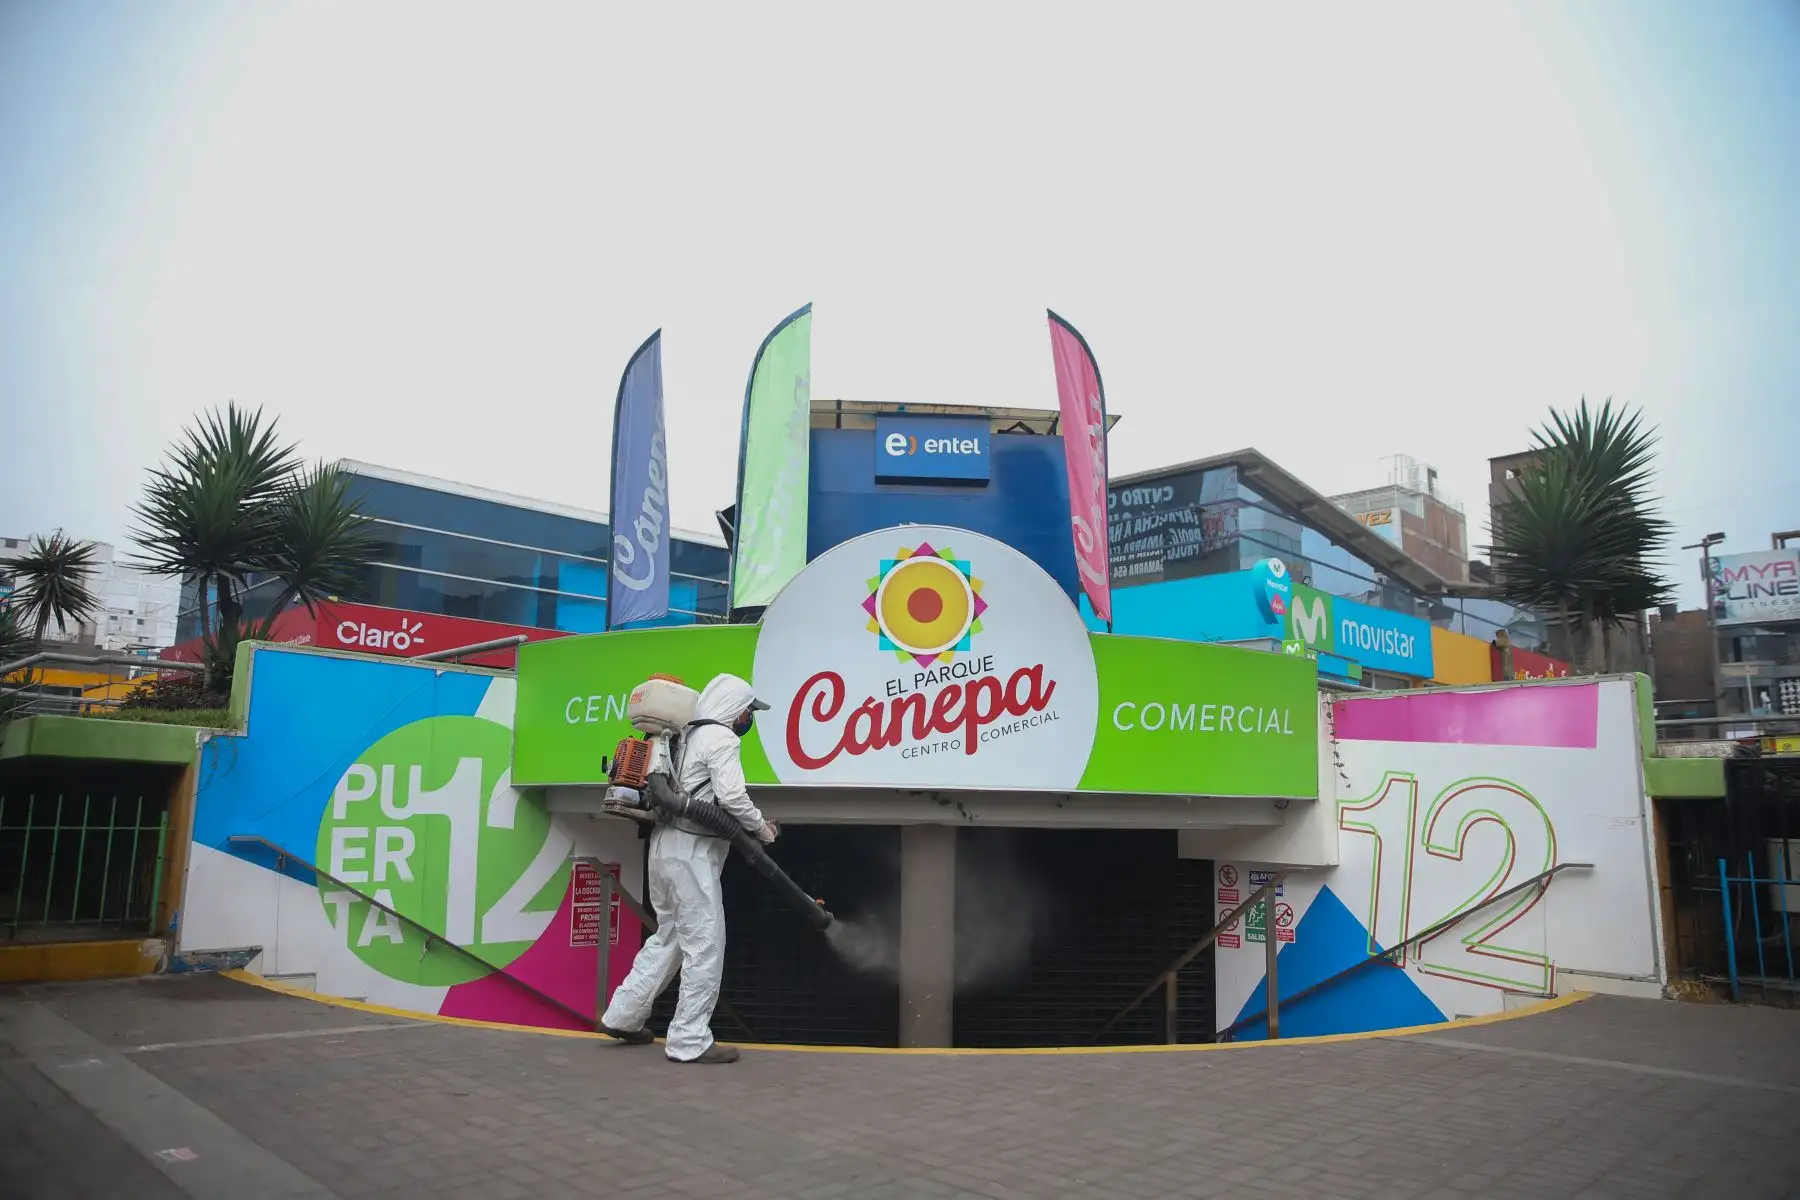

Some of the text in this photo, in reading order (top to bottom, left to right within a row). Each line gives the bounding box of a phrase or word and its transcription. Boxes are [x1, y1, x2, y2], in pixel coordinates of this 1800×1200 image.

[924, 437, 981, 456] entel
[1727, 579, 1799, 600] LINE
[336, 620, 411, 650] Claro
[1341, 618, 1416, 660] movistar
[886, 655, 995, 697] EL PARQUE
[565, 693, 627, 725] CEN
[786, 663, 1057, 771] Cánepa
[1112, 701, 1295, 735] COMERCIAL
[901, 710, 1061, 760] CENTRO COMERCIAL
[414, 756, 577, 947] 12
[1337, 770, 1559, 999] 12
[1247, 933, 1266, 941] SALID
